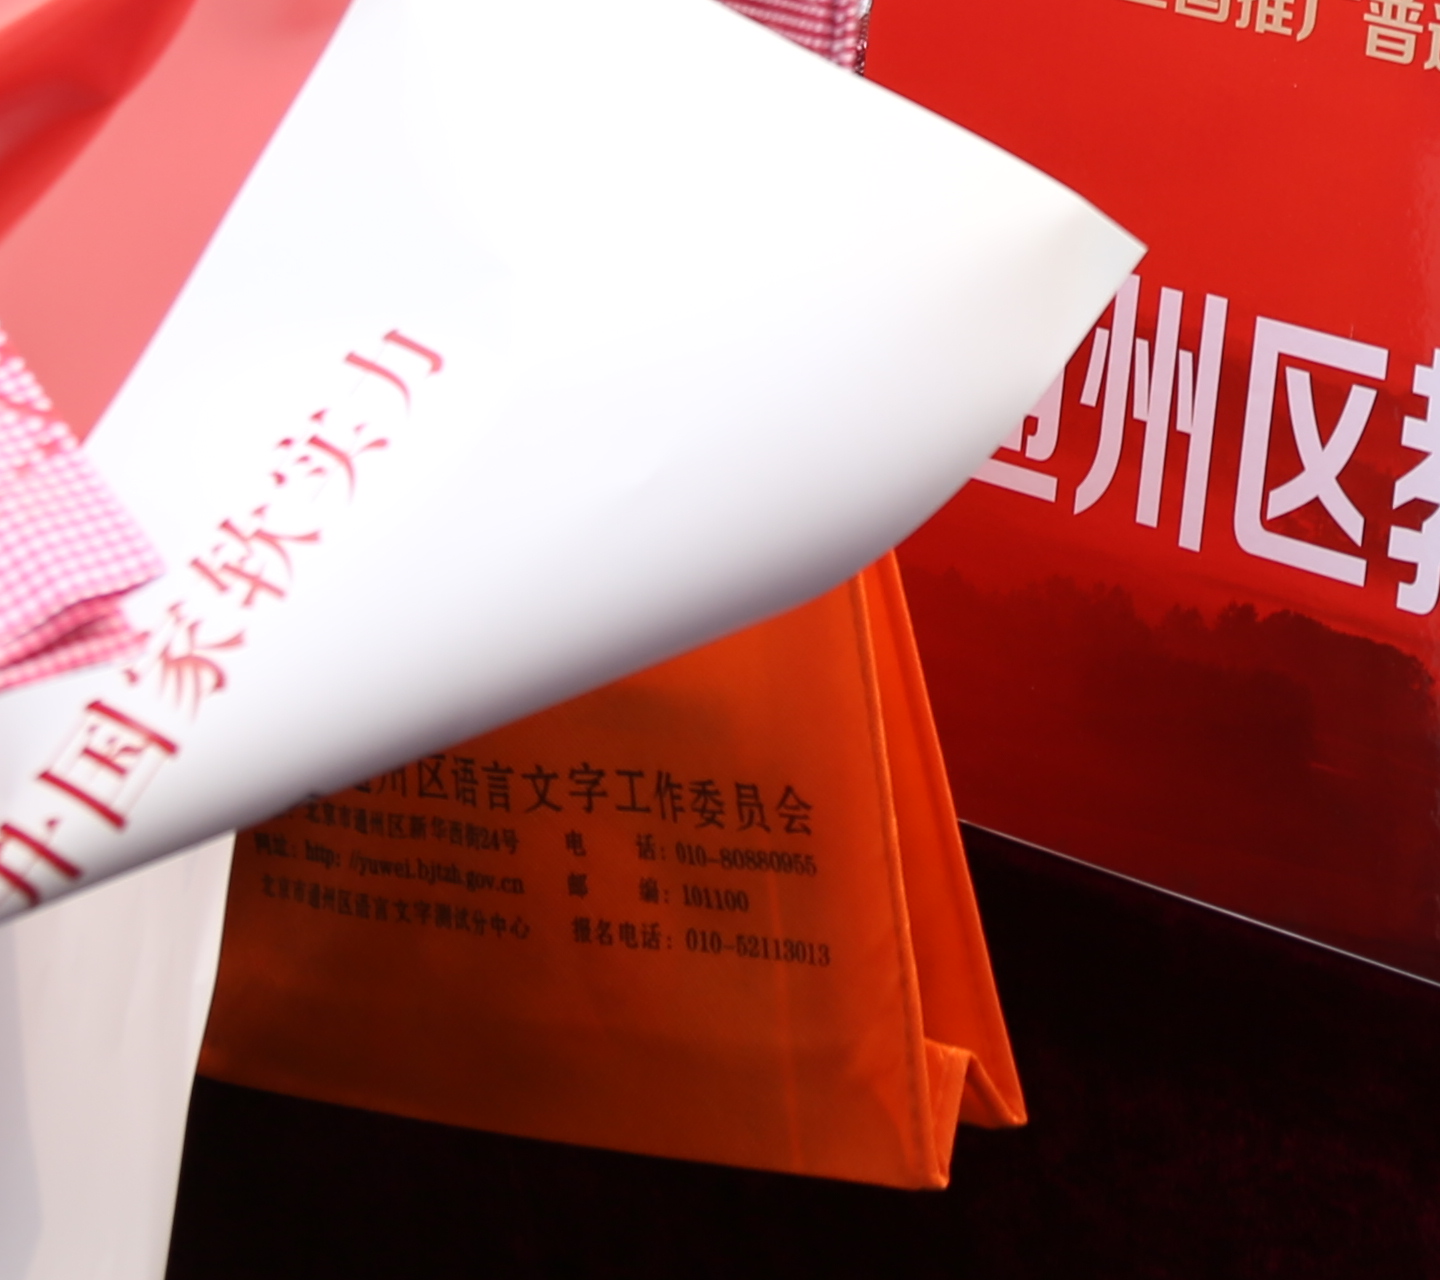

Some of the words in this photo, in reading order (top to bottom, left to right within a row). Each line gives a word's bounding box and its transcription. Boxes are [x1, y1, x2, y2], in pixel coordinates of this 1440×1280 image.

[352, 753, 814, 837] 州区语言文字工作委员会
[563, 829, 588, 859] 电
